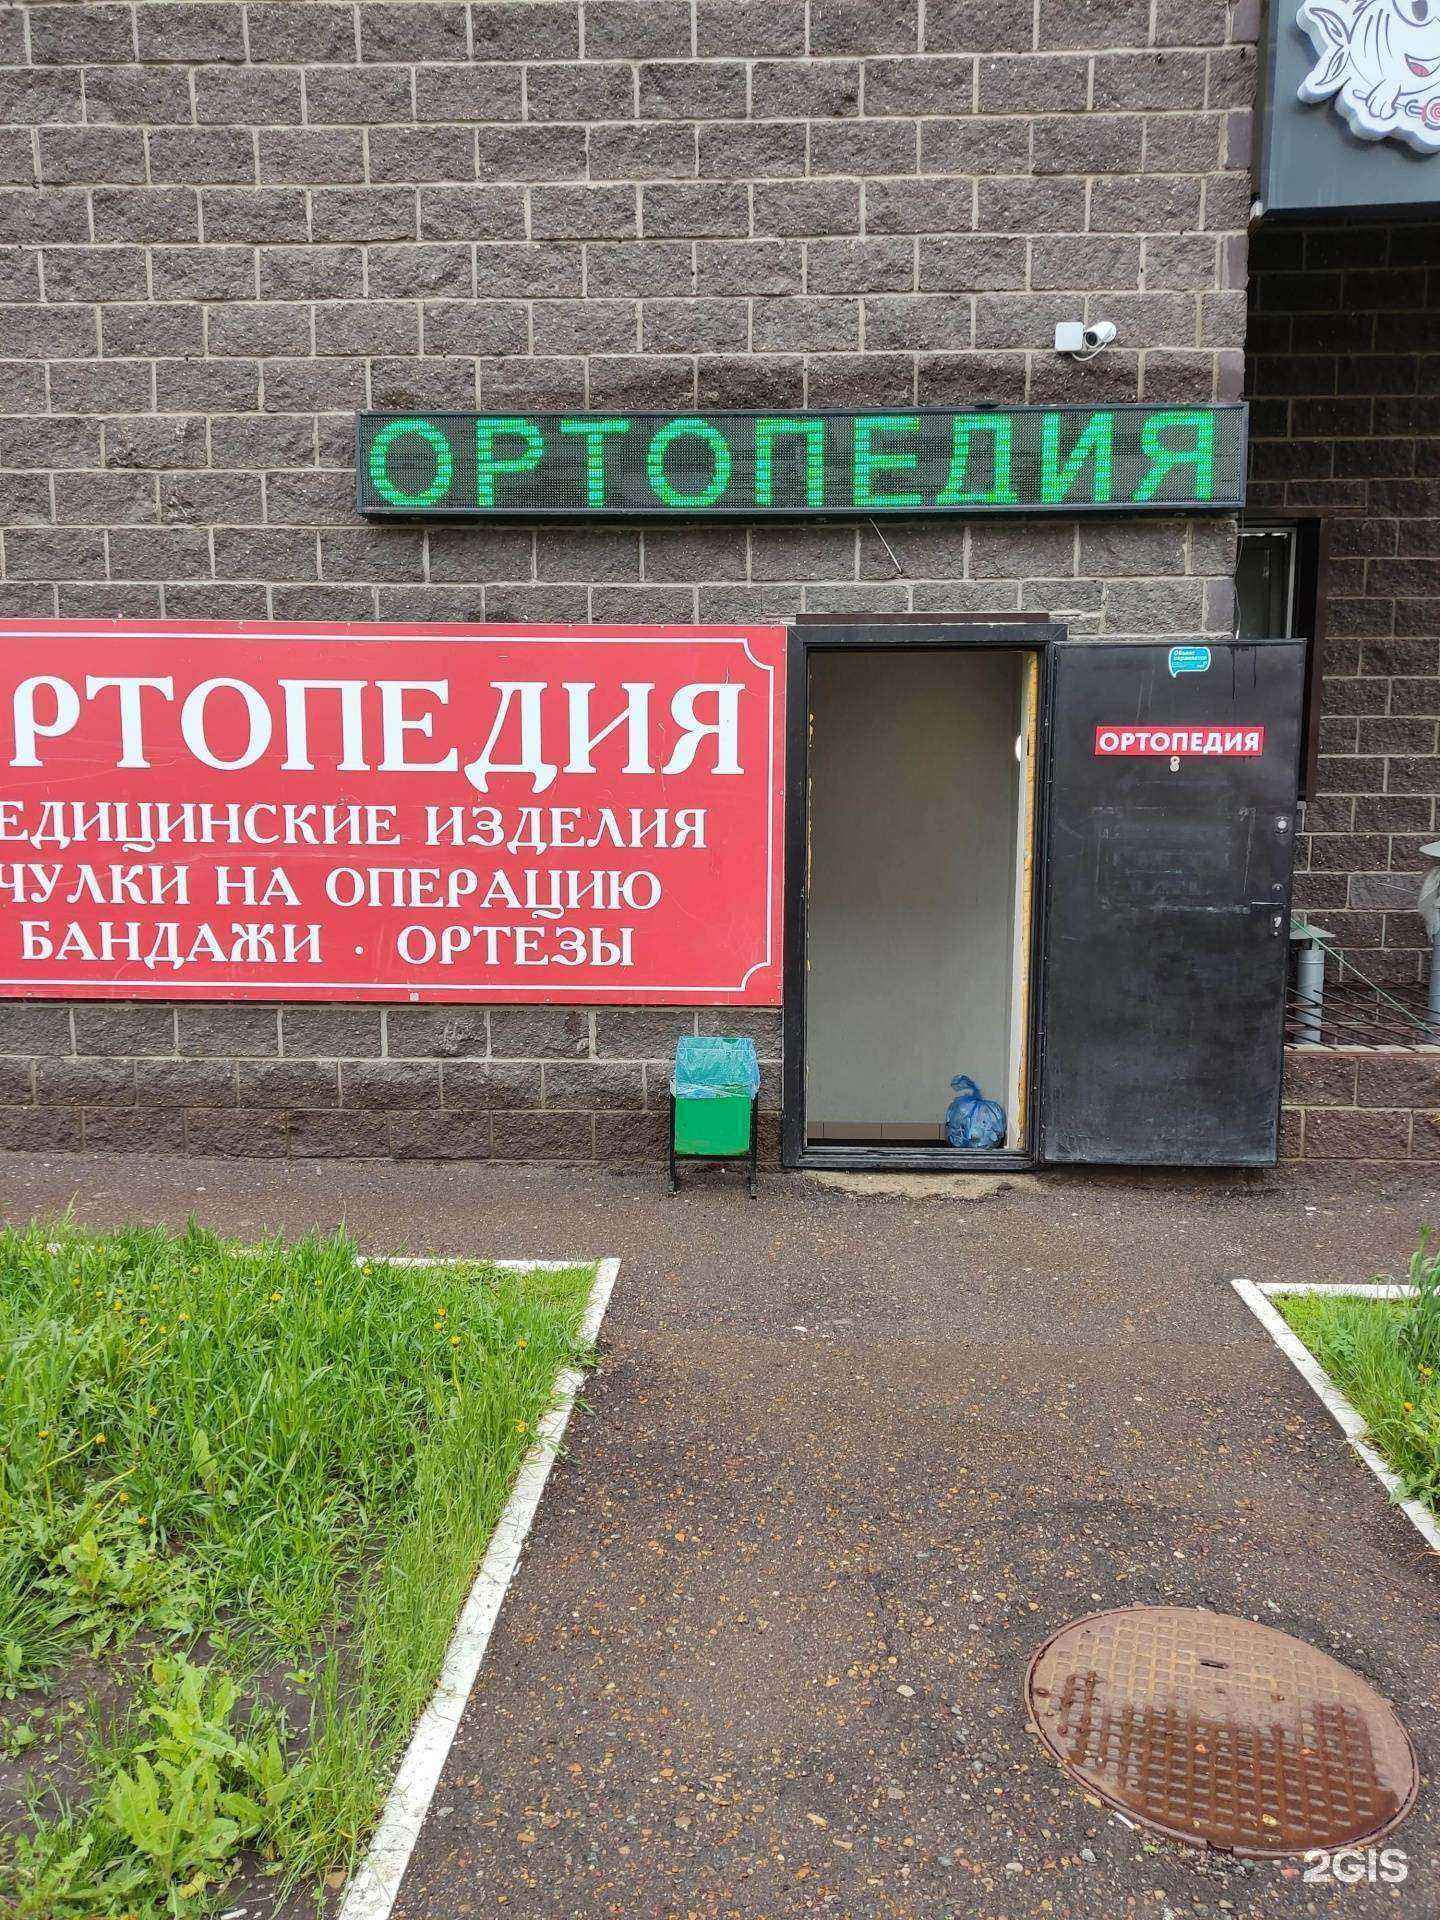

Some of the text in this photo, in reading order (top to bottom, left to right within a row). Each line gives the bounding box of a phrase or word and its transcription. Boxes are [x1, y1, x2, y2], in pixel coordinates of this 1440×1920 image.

[367, 411, 1217, 509] ОРТОПЕДИЯ
[8, 673, 747, 794] РТОПЕДИЯ
[1097, 731, 1261, 754] ОРТОПЕДИЯ
[0, 799, 708, 856] ЕДИЦИНСКИЕ ИЗДЕЛИЯ
[0, 862, 663, 920] ЧУЛКИ НА ОПЕРАЦИЮ
[18, 919, 636, 971] БАНДАЖИ ОРТЕЗЫ
